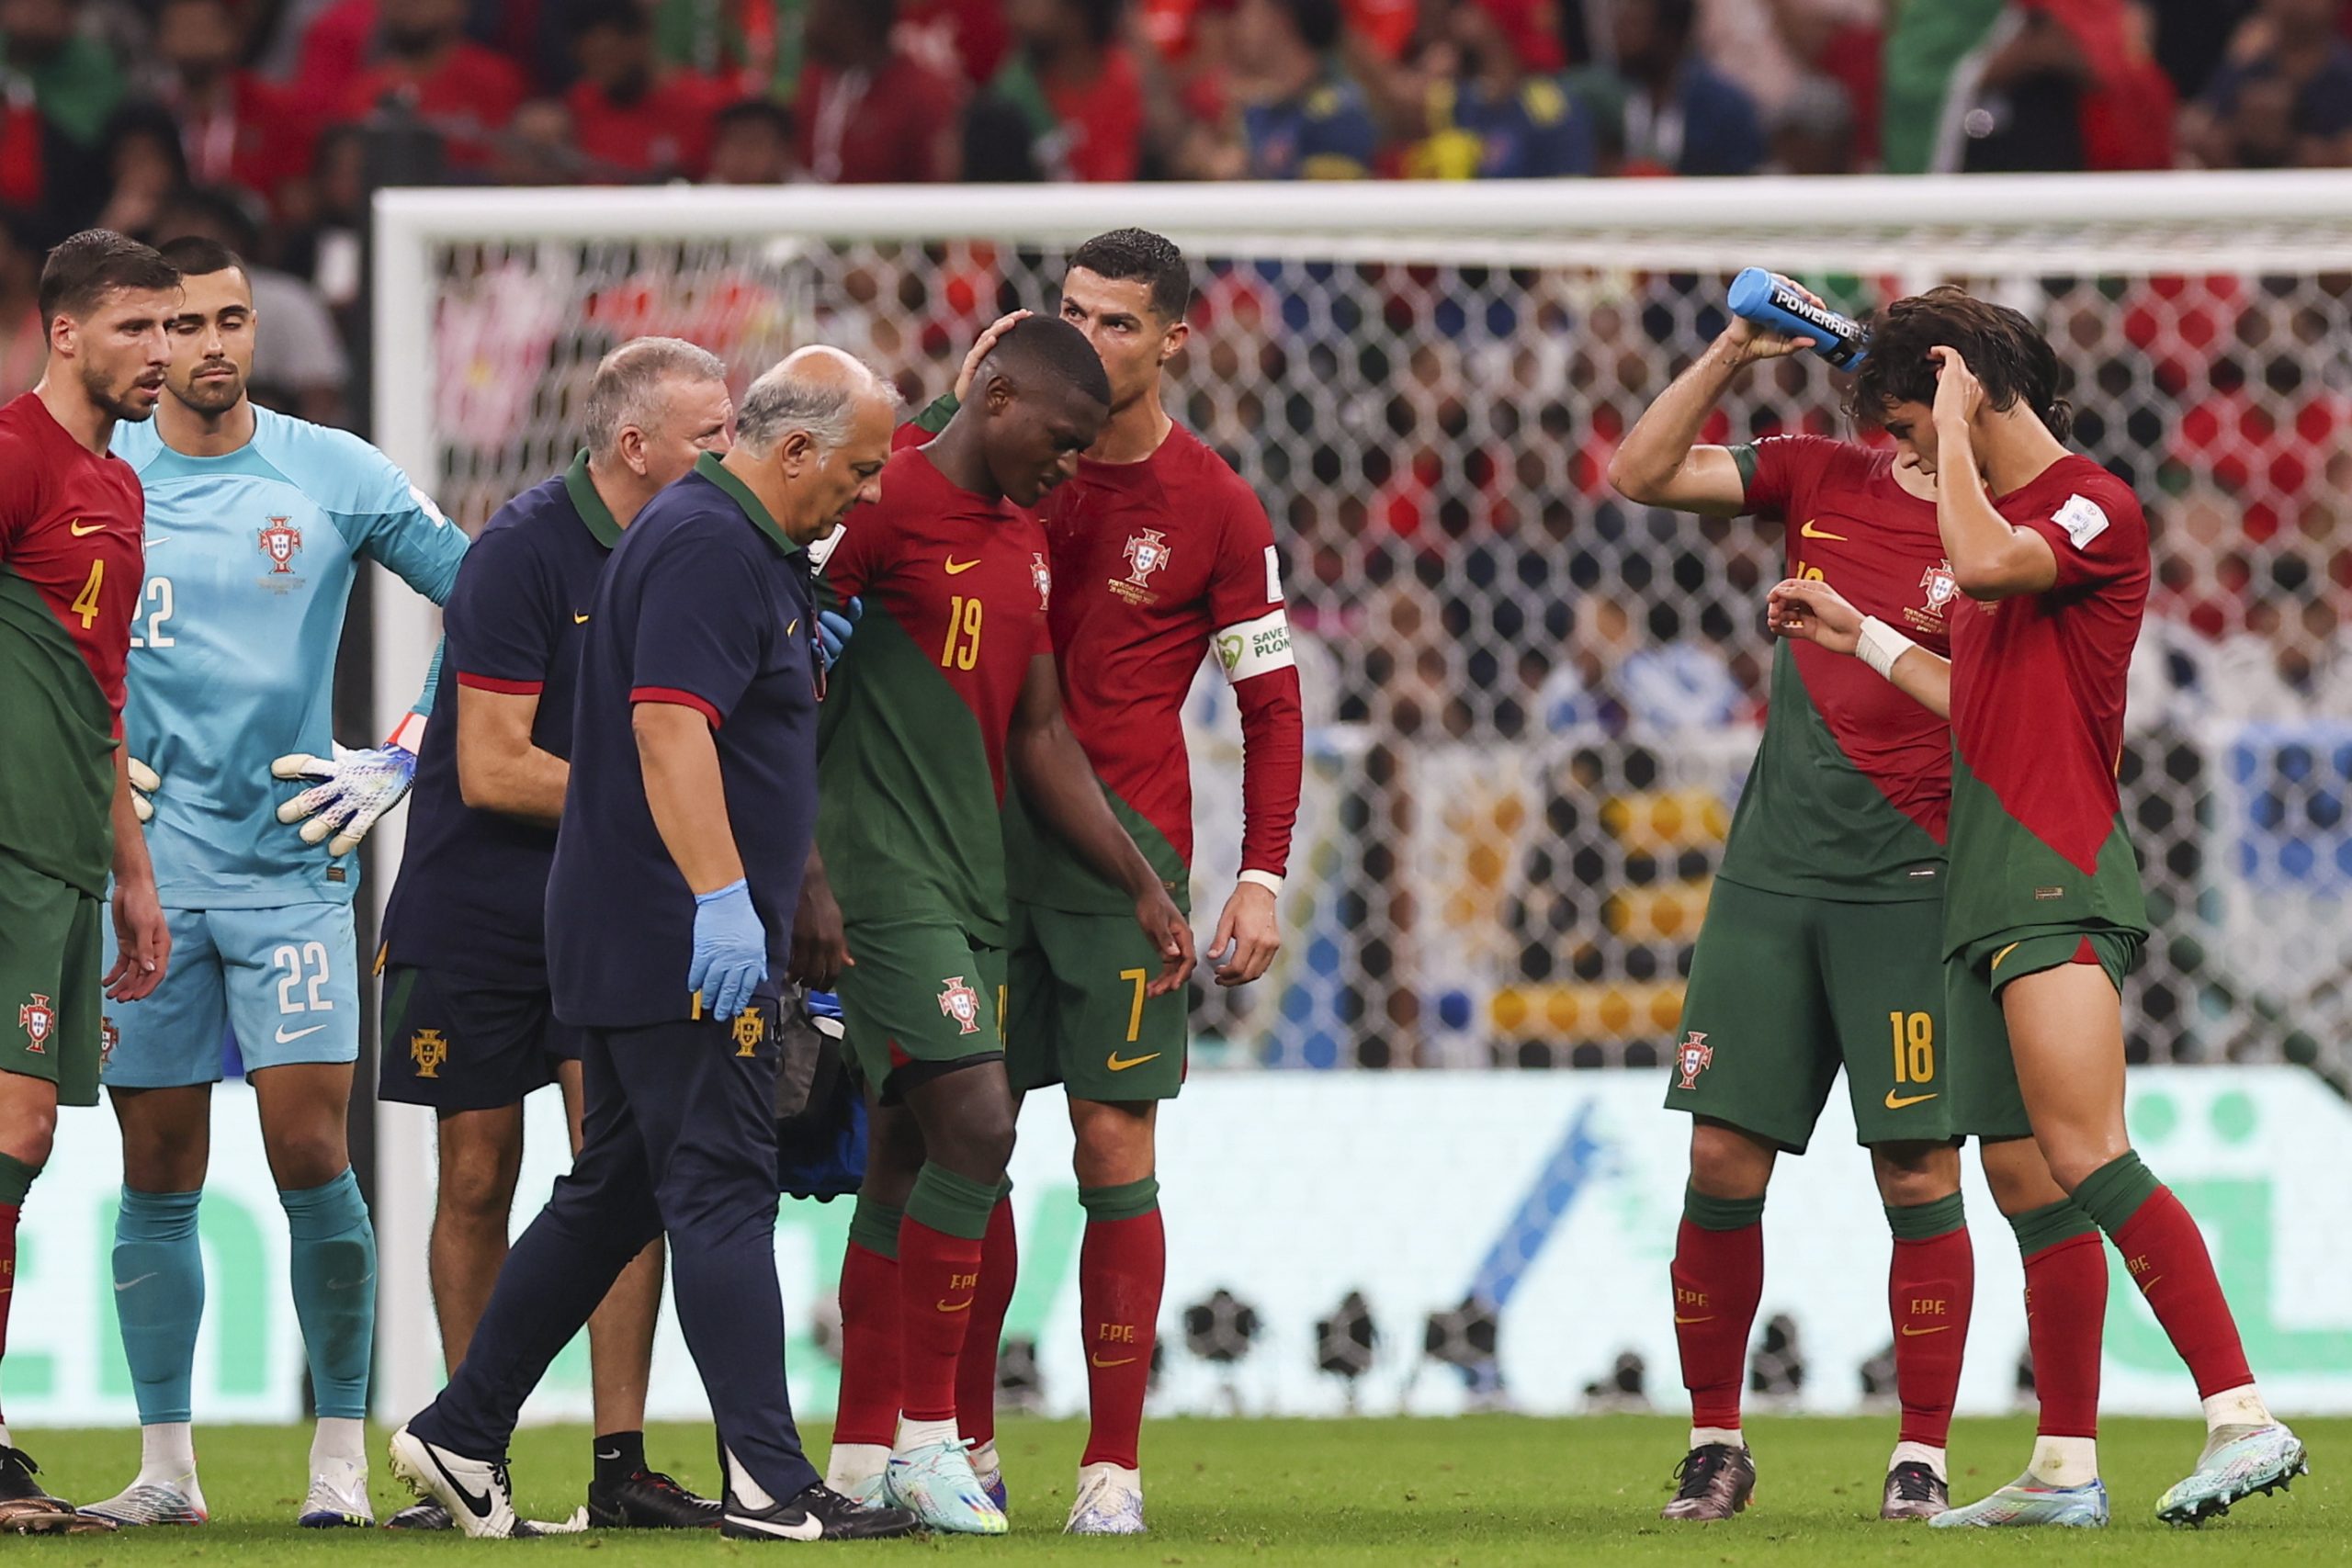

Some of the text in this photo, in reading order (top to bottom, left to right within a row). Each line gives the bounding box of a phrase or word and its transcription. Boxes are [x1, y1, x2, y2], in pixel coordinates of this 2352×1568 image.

[71, 558, 104, 629] 4
[941, 596, 982, 671] 19
[1252, 627, 1283, 645] SAVE
[274, 941, 334, 1015] 22
[1120, 968, 1146, 1042] 7
[1890, 1011, 1934, 1083] 18
